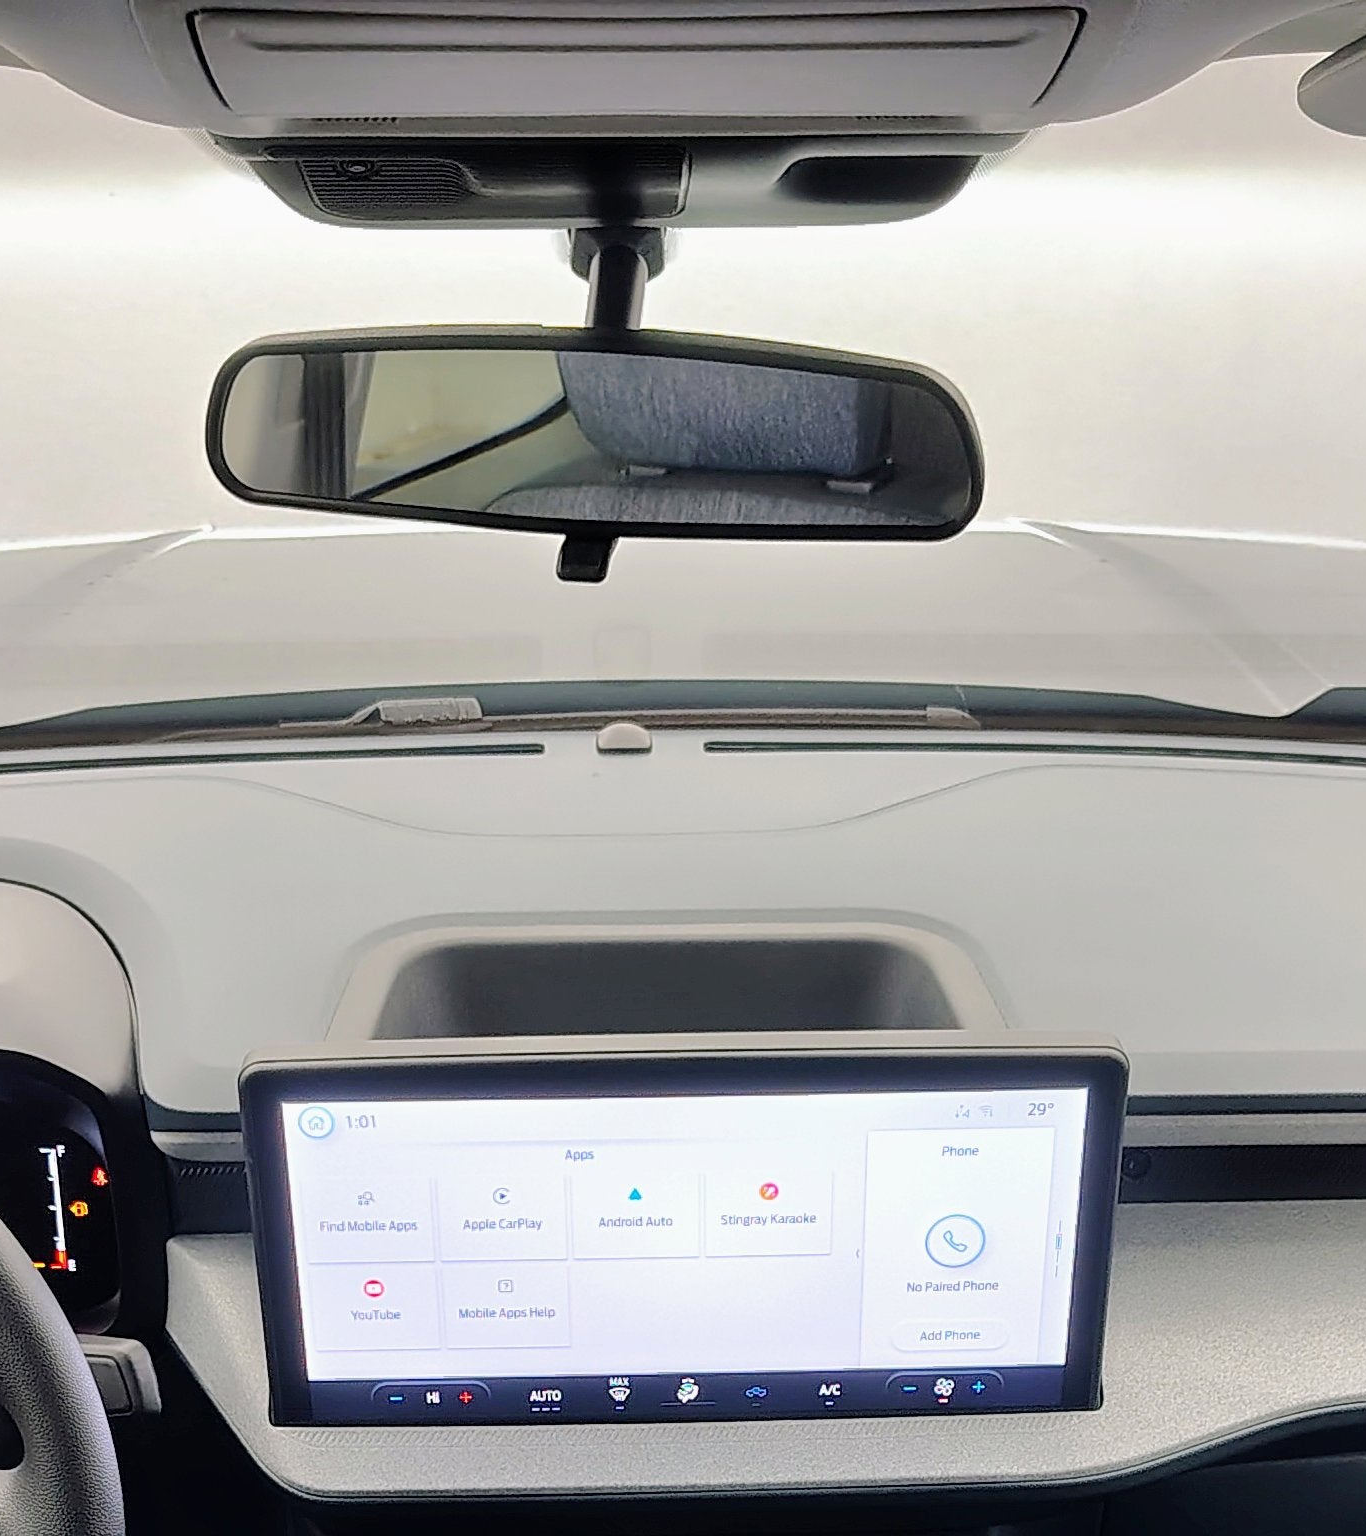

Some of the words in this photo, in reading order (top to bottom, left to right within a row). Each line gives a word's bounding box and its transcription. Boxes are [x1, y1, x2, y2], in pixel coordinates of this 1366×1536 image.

[346, 1115, 377, 1129] 1:01
[565, 1149, 594, 1161] Apps
[942, 1146, 979, 1156] Phone
[463, 1218, 496, 1232] Apple
[498, 1218, 543, 1232] CarPlay
[598, 1216, 643, 1228] Android
[646, 1215, 673, 1227] Auto
[720, 1213, 767, 1227] Stingray
[770, 1213, 817, 1224] Karaoke
[319, 1221, 344, 1232] Find
[347, 1220, 386, 1232] Mobile
[388, 1220, 418, 1233] Apps
[906, 1282, 922, 1292] No
[925, 1281, 960, 1292] Paired
[963, 1280, 999, 1291] Phone
[351, 1309, 401, 1320] YouTube
[458, 1308, 497, 1319] Mobile
[499, 1307, 527, 1320] Apps
[529, 1306, 556, 1319] Help
[920, 1331, 943, 1341] Add
[945, 1330, 981, 1341] Phone
[609, 1377, 629, 1387] MAX
[529, 1389, 562, 1402] AUTO
[818, 1384, 841, 1396] A/C
